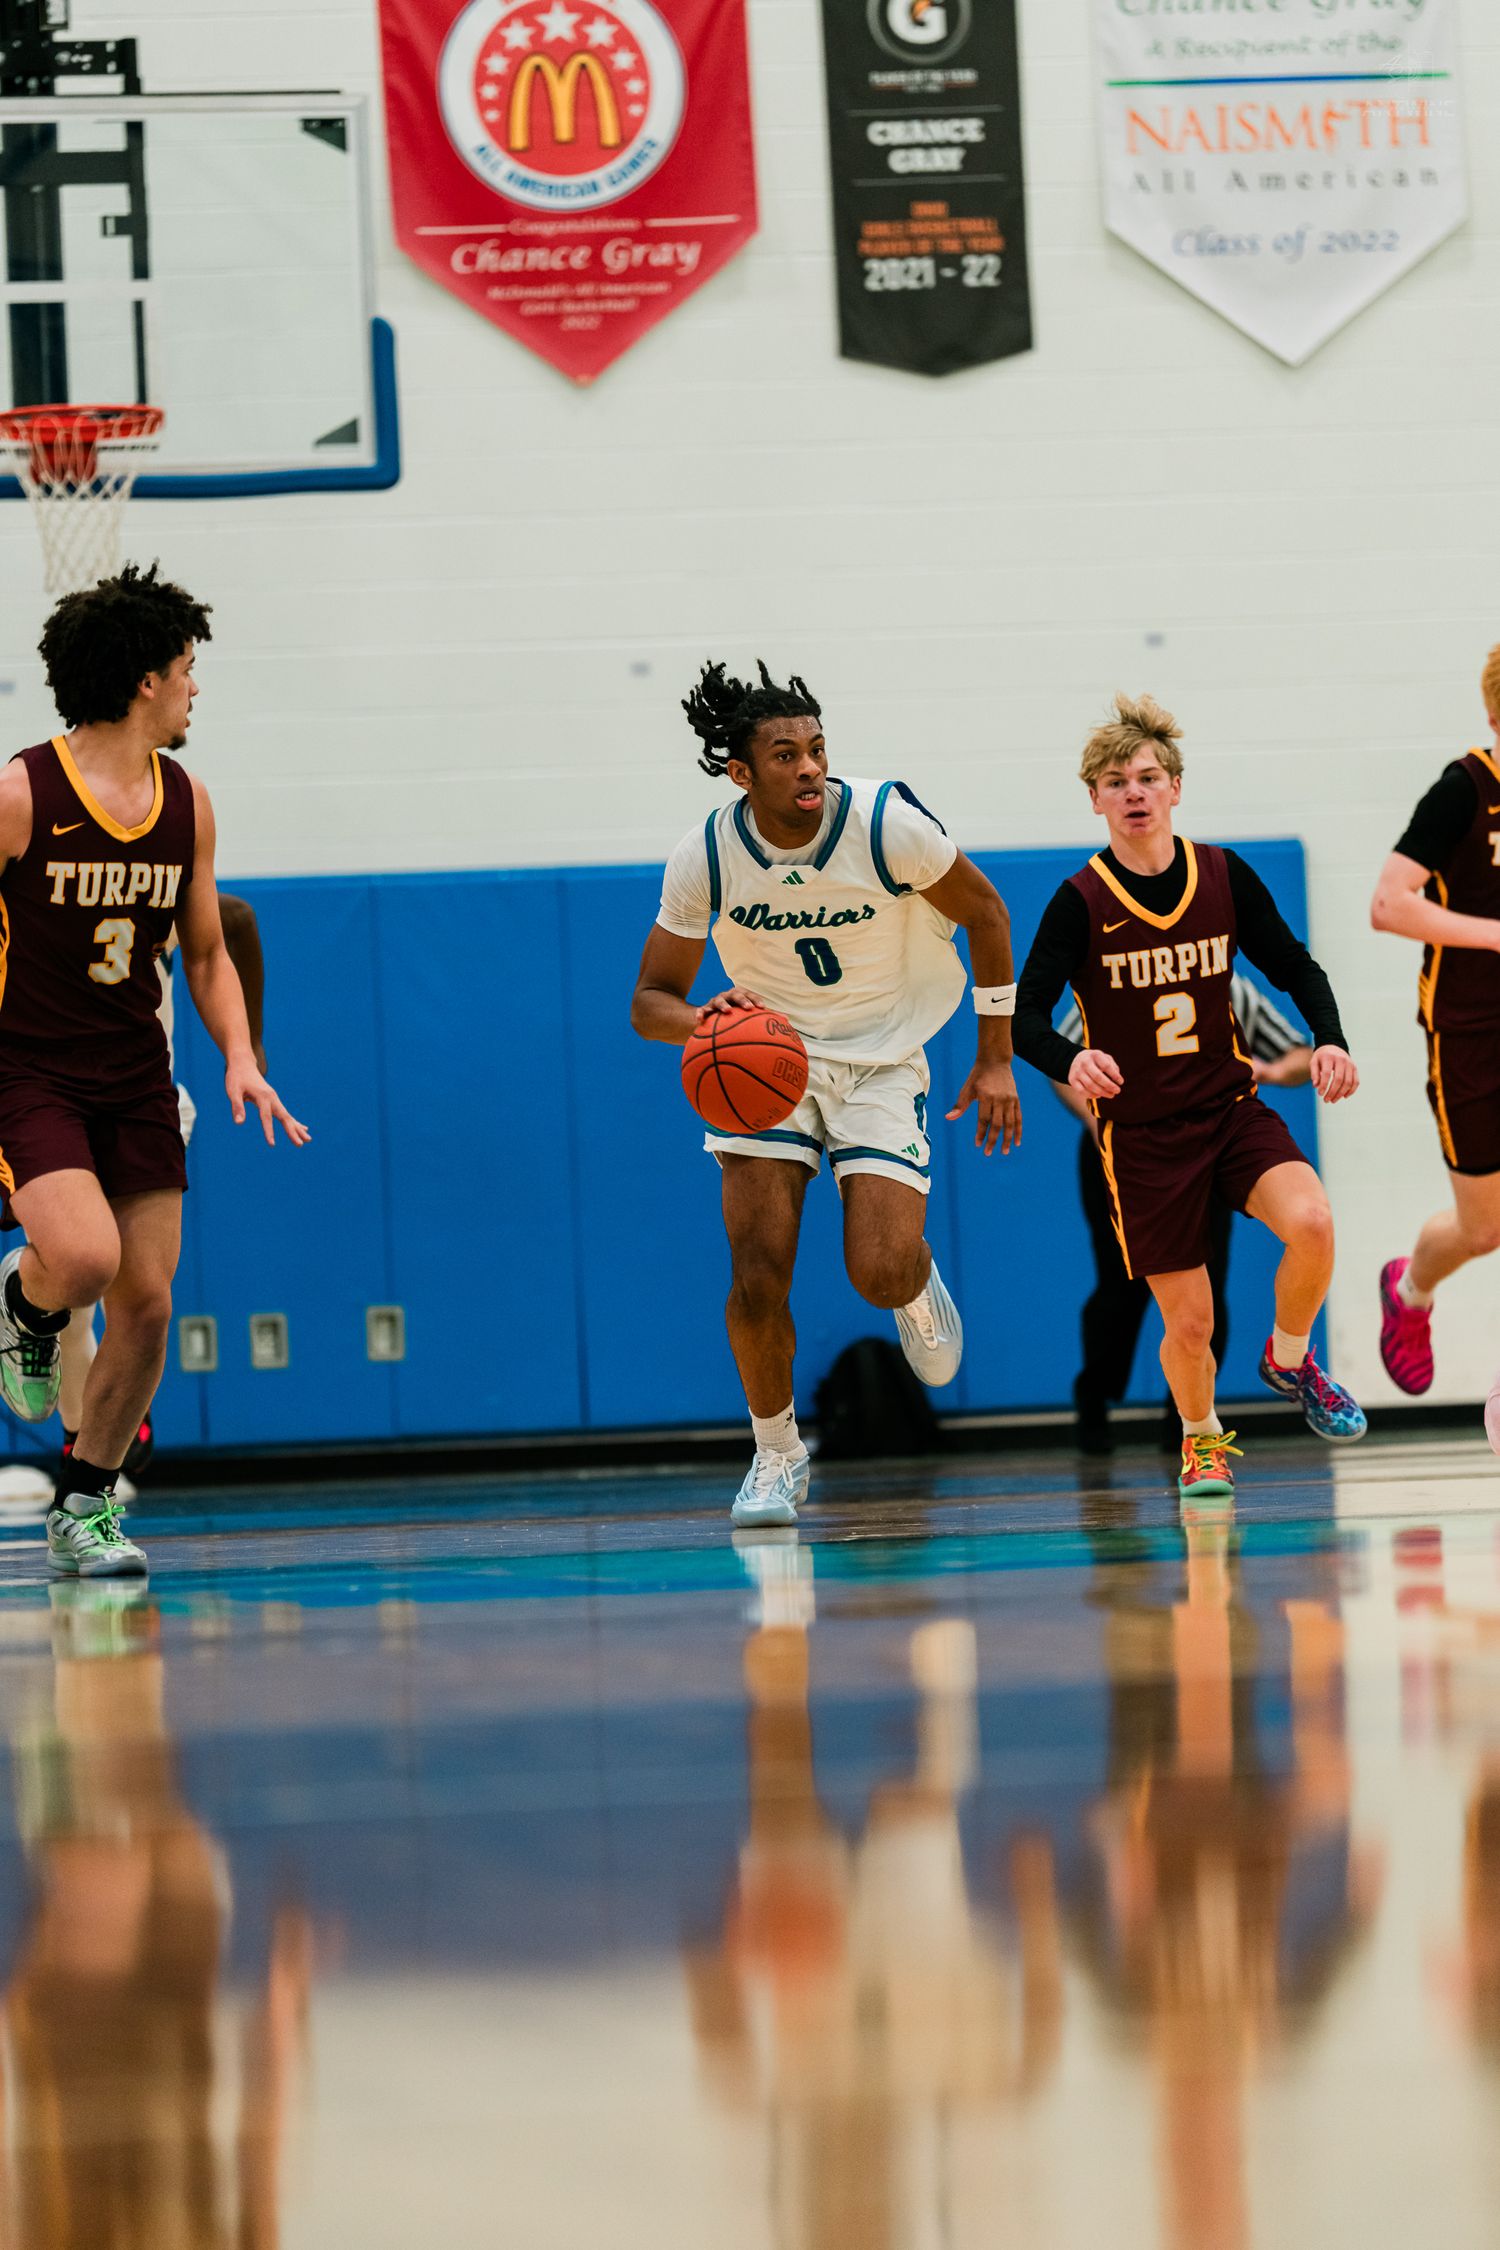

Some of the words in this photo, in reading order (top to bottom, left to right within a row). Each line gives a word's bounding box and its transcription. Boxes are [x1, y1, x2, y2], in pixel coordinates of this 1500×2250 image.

[866, 118, 986, 146] CHANCE
[887, 147, 966, 173] GRAY
[1129, 168, 1197, 194] All
[1224, 166, 1439, 193] American
[450, 238, 592, 275] Chance
[602, 236, 703, 276] Gray
[1172, 225, 1262, 258] Class
[1272, 223, 1315, 264] of
[1319, 227, 1400, 254] 2022
[863, 256, 936, 291] 2021
[961, 254, 1002, 287] 22
[46, 861, 183, 909] TURPIN
[729, 903, 877, 932] Warriors
[88, 917, 136, 985] 3
[794, 937, 843, 986] 0
[1101, 934, 1230, 989] TURPIN
[1153, 991, 1200, 1058] 2
